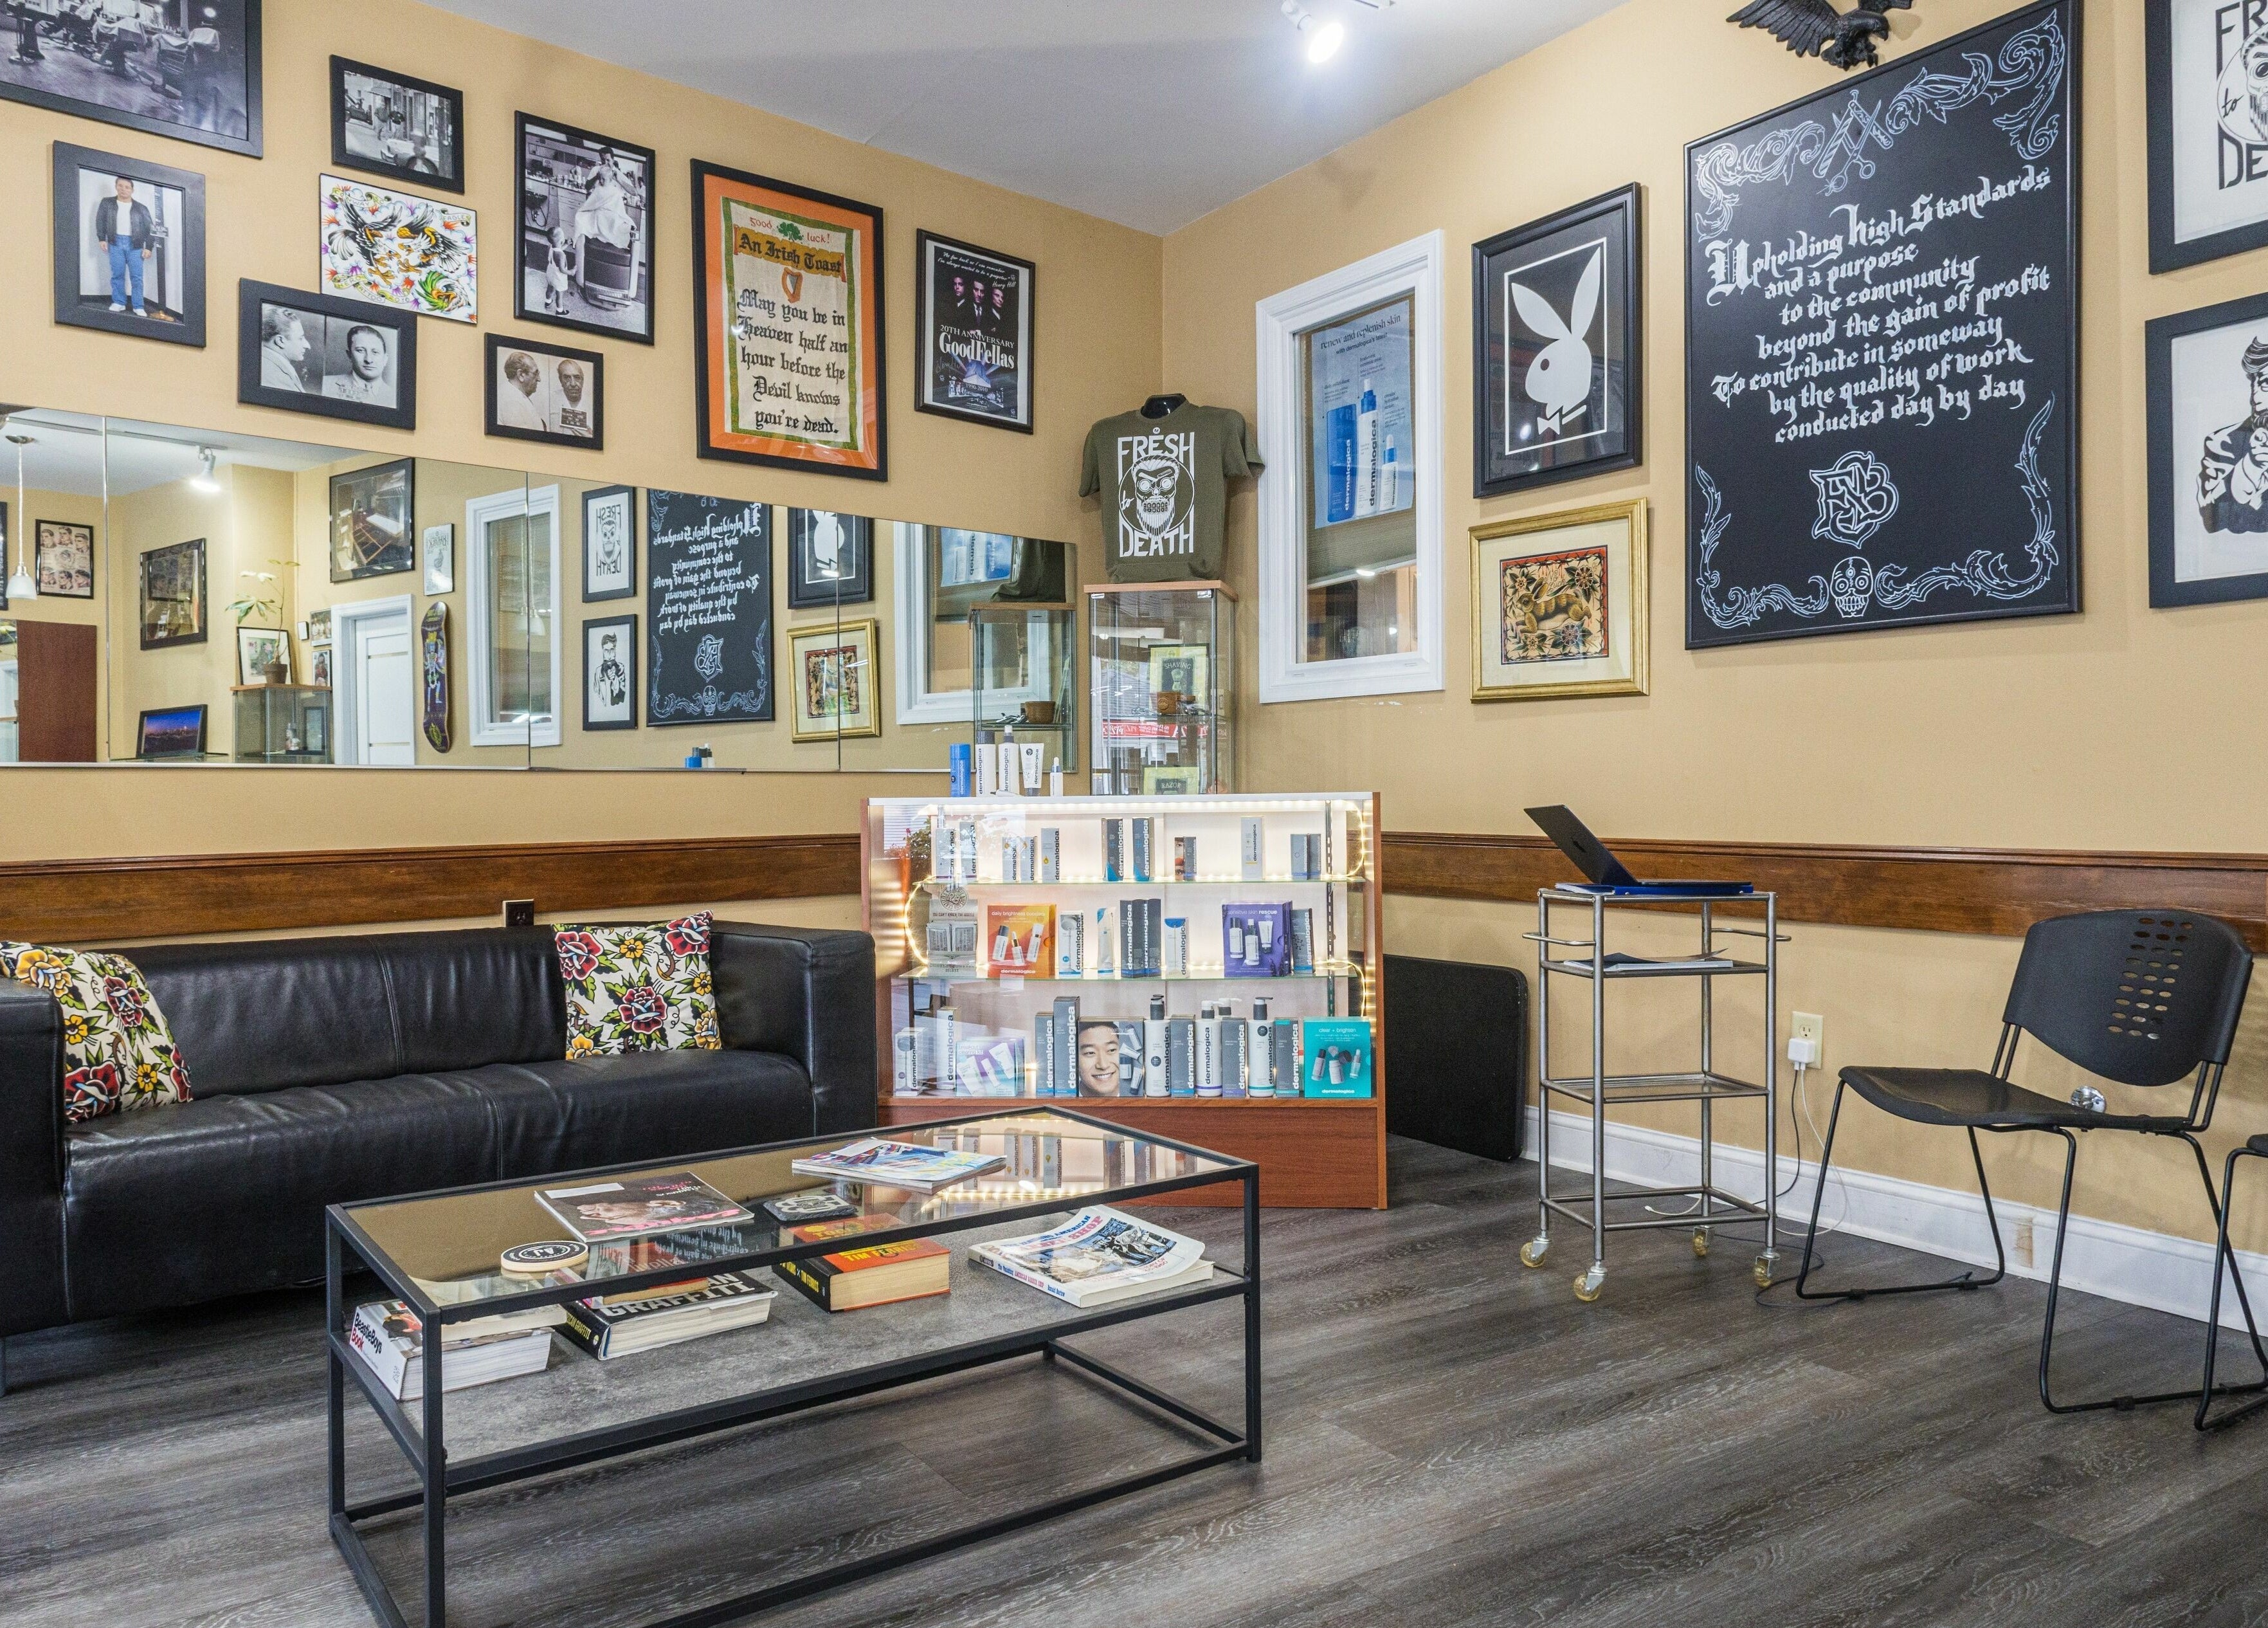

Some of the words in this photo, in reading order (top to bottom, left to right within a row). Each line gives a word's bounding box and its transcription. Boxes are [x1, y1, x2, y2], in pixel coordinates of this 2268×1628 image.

[2222, 87, 2244, 119] to
[739, 232, 762, 255] An
[765, 240, 800, 268] Irish
[804, 252, 842, 273] Toast
[806, 232, 831, 244] luck!
[1705, 230, 1844, 306] Upholding
[1904, 165, 2051, 234] Standards
[992, 280, 1006, 289] Henry
[1765, 266, 1804, 299] and
[1808, 270, 1822, 287] a
[1827, 243, 1918, 294] purpose
[1779, 302, 1803, 325] to
[1808, 293, 1842, 319] the
[1846, 255, 1980, 307] community
[737, 288, 776, 318] May
[781, 304, 808, 322] you
[812, 307, 828, 324] be
[832, 310, 846, 327] in
[1755, 318, 1837, 366] beyond
[1842, 313, 1880, 338] the
[1883, 295, 1939, 337] gain
[1943, 284, 1975, 313] of
[1975, 263, 2051, 316] profit
[738, 315, 794, 344] Heaven
[799, 331, 828, 354] half
[830, 340, 848, 354] an
[939, 332, 1015, 369] GoodFellas
[940, 324, 960, 335] 20TH
[961, 329, 1015, 349] ANNIVERSARY
[1320, 337, 1342, 350] renew
[1343, 329, 1356, 343] and
[1356, 319, 1386, 338] replenish
[1387, 314, 1401, 327] skin
[741, 345, 776, 370] hour
[780, 352, 822, 378] before
[825, 361, 846, 385] the
[1710, 370, 1746, 408] To
[1749, 348, 1859, 390] contribute
[1864, 342, 1885, 364] in
[1887, 316, 2003, 362] someway
[751, 374, 793, 402] Devil
[795, 383, 841, 407] knows
[1767, 390, 1797, 425] by
[1799, 381, 1836, 408] the
[1840, 365, 1921, 410] quality
[1926, 353, 1954, 381] of
[1955, 338, 2035, 374] work
[754, 408, 800, 430] you're
[803, 414, 839, 434] dead.
[1775, 399, 1884, 443] conducted
[1891, 393, 1936, 426] day
[1936, 383, 1972, 421] by
[1978, 374, 2026, 410] day
[1118, 432, 1195, 485] FRESH
[1369, 419, 1377, 506] dermalogica
[1121, 490, 1134, 511] to
[1118, 504, 1195, 557] DEATH
[1054, 1214, 1091, 1238] AMERICAN
[1068, 1215, 1103, 1239] SHOP
[844, 1252, 871, 1261] TIM
[599, 1281, 755, 1317] GRAFFITI
[351, 1327, 365, 1353] Book
